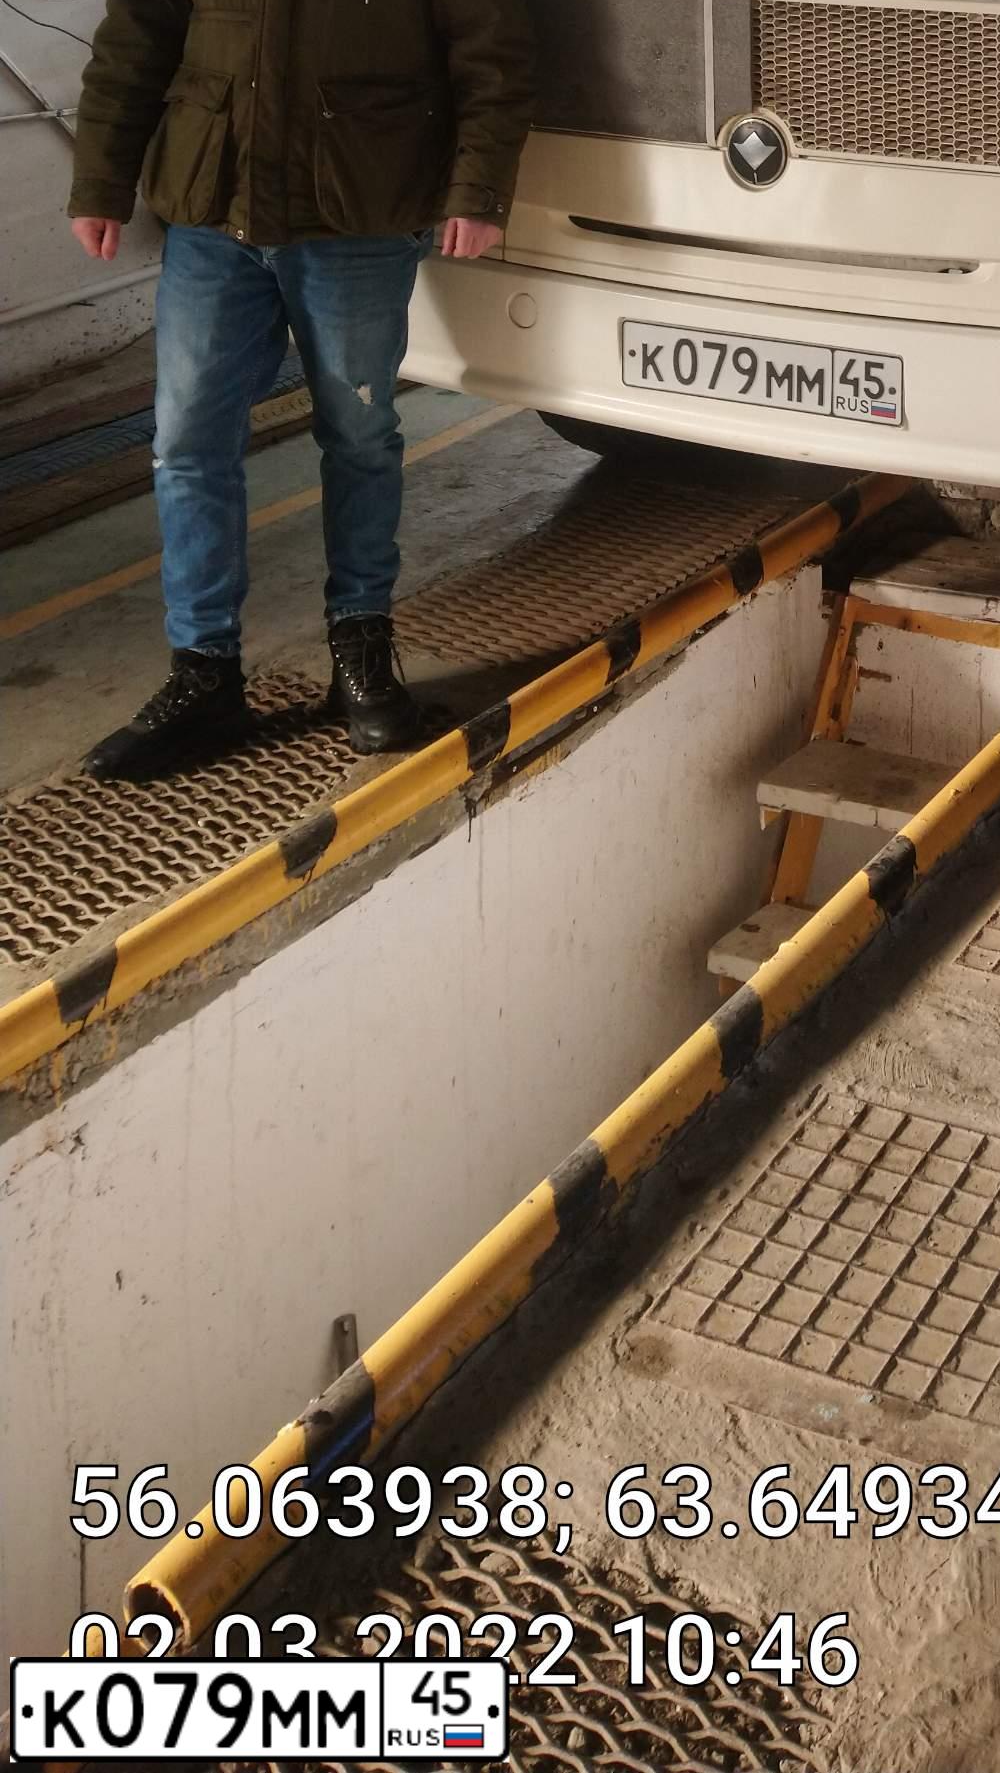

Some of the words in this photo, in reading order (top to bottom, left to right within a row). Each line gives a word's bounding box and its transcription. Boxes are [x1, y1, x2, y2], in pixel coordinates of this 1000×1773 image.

[641, 338, 825, 407] К079ММ
[839, 359, 885, 400] 45
[836, 396, 870, 414] RUS
